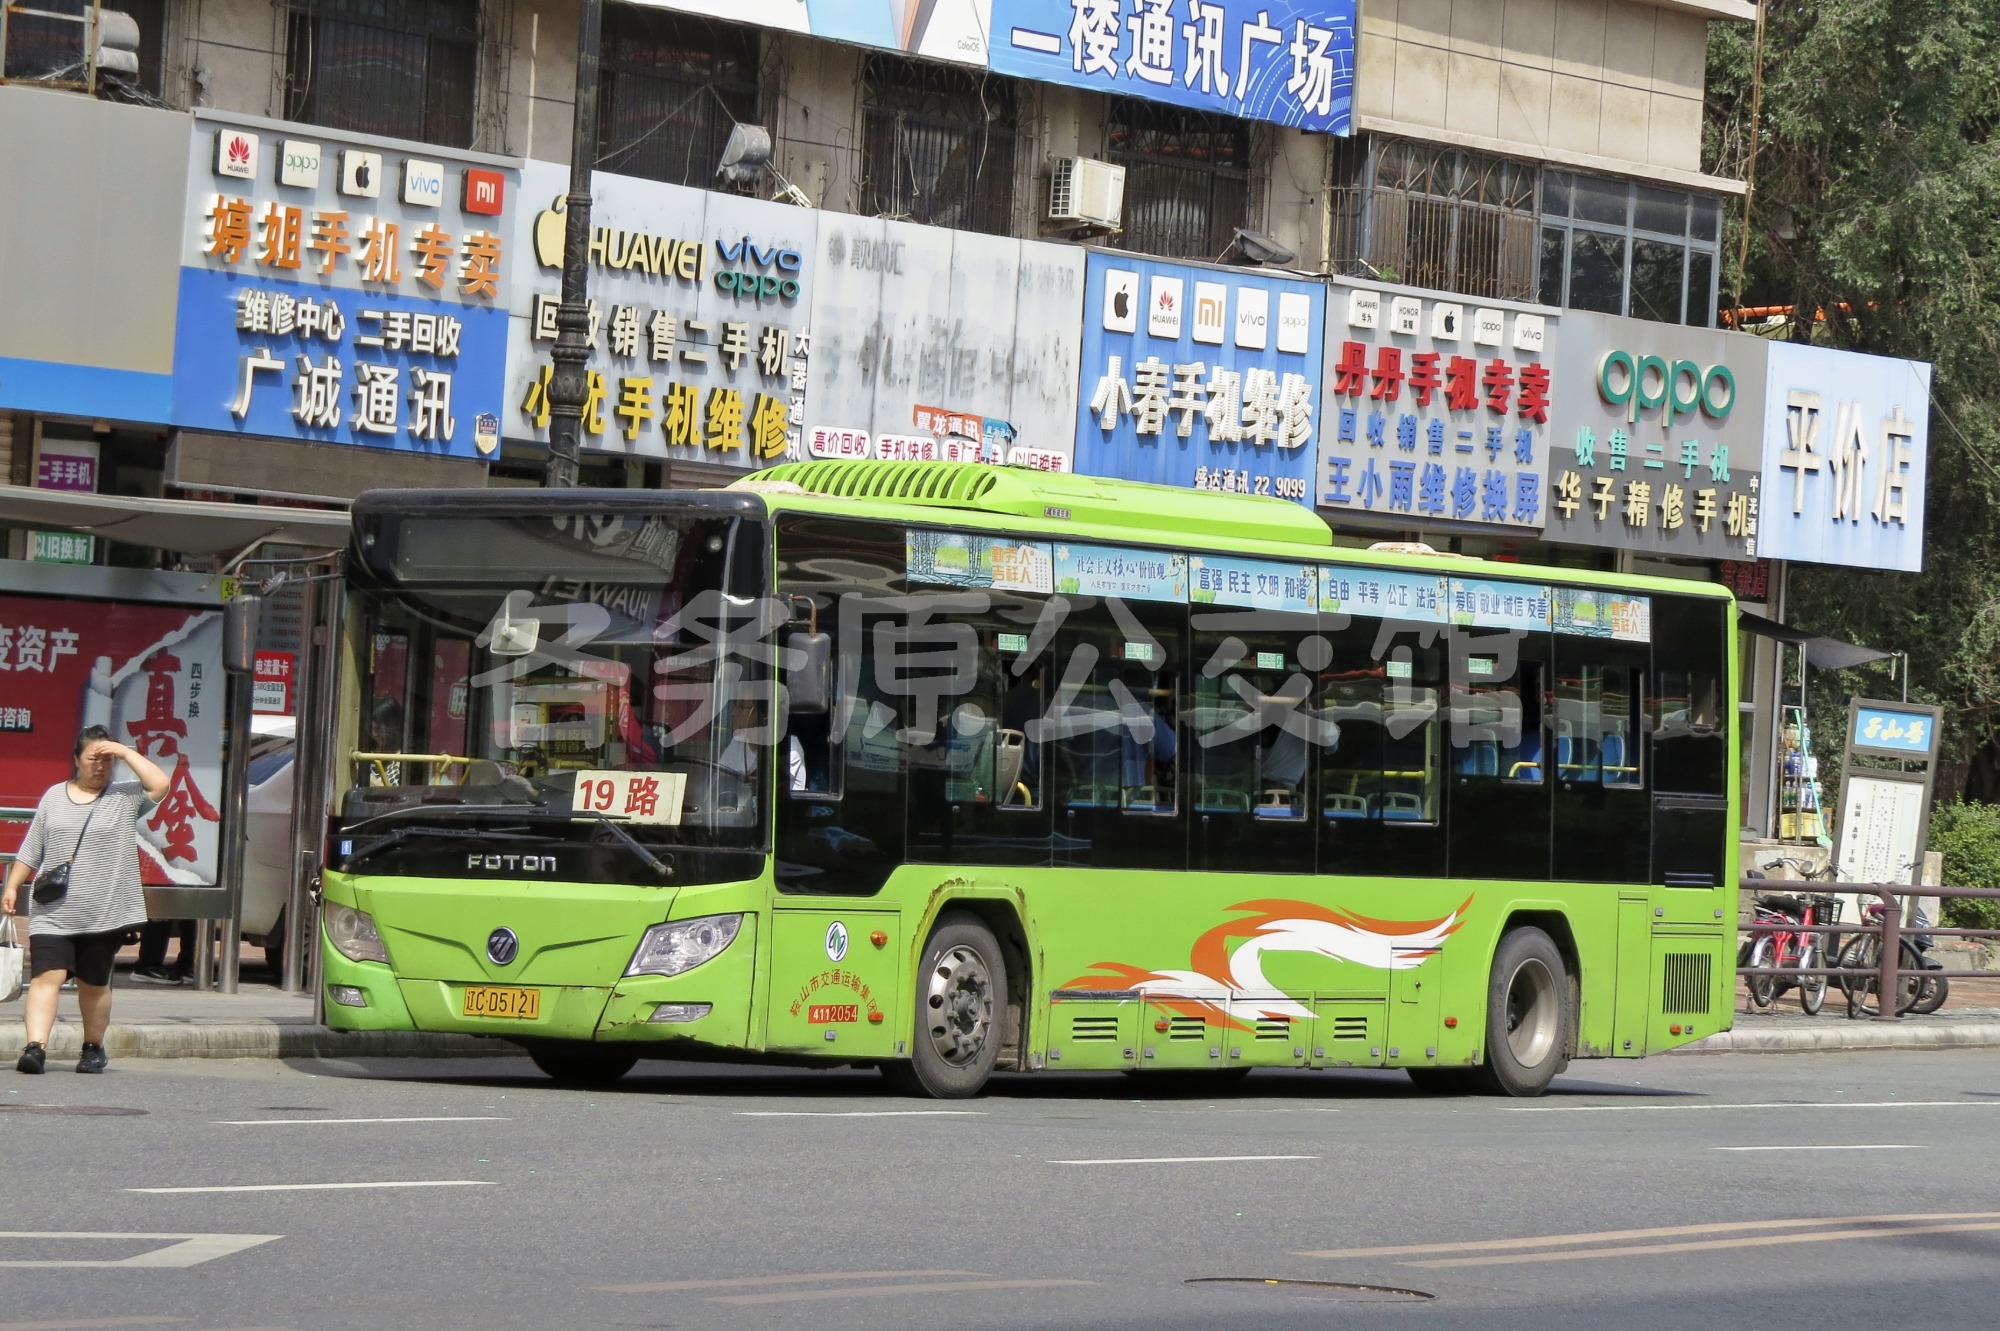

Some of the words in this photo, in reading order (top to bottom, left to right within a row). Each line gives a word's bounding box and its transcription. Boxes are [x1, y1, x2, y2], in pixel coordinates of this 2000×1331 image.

[1011, 0, 1335, 116] 一楼通讯广场
[227, 165, 250, 174] HUAWEI
[410, 172, 440, 194] vivo
[205, 194, 502, 299] 婷姐手机专卖
[588, 225, 707, 281] HUAWEI
[716, 235, 802, 271] vivo
[1240, 312, 1266, 325] vivo
[1356, 299, 1378, 310] HUAWEI
[1361, 312, 1372, 323] 华为
[1399, 306, 1419, 316] HONOR
[237, 288, 346, 341] 维修中心
[354, 309, 463, 357] 二手回收
[1152, 314, 1179, 326] HUAWEI
[1522, 327, 1542, 340] vivo
[230, 348, 456, 441] 广诚通讯
[784, 326, 811, 461] 大器通讯
[1334, 341, 1551, 425] 丹丹手机专卖
[1090, 355, 1314, 448] 小春手机维修
[812, 430, 868, 456] 高价回收
[880, 438, 934, 461] 手机快修
[1338, 408, 1534, 464] 回收销售二手机
[1575, 424, 1731, 483] 收售二手机
[1780, 389, 1915, 524] 平价店
[39, 460, 91, 486] 二手手机
[1254, 475, 1270, 496] 22
[1275, 477, 1307, 498] 9099
[1325, 456, 1540, 523] 王小雨维修换屏
[1553, 469, 1749, 537] 华子精修手机
[34, 535, 88, 561] 以旧换新
[992, 546, 1031, 565] 勤劳人
[992, 564, 1032, 584] 吉祥人
[1077, 554, 1166, 580] 社会主义核心价值观
[1200, 567, 1223, 592] 富强
[1229, 570, 1251, 594] 民主
[1257, 573, 1279, 597] 文明
[1285, 576, 1308, 600] 和谐
[1329, 578, 1349, 601] 自由
[1358, 581, 1379, 604] 平等
[1388, 583, 1408, 607] 公正
[1416, 586, 1437, 609] 法治
[1455, 590, 1476, 614] 爱国
[1480, 592, 1500, 615] 敬业
[1504, 594, 1524, 617] 诚信
[1527, 595, 1548, 619] 友善
[188, 663, 203, 718] 四步换
[0, 708, 31, 729] 咨询
[580, 779, 615, 810] 19
[624, 776, 660, 816] 路
[468, 854, 557, 871] FOTON
[790, 968, 878, 1018] 鞍山市交通运输集团
[813, 1005, 858, 1022] 4112054
